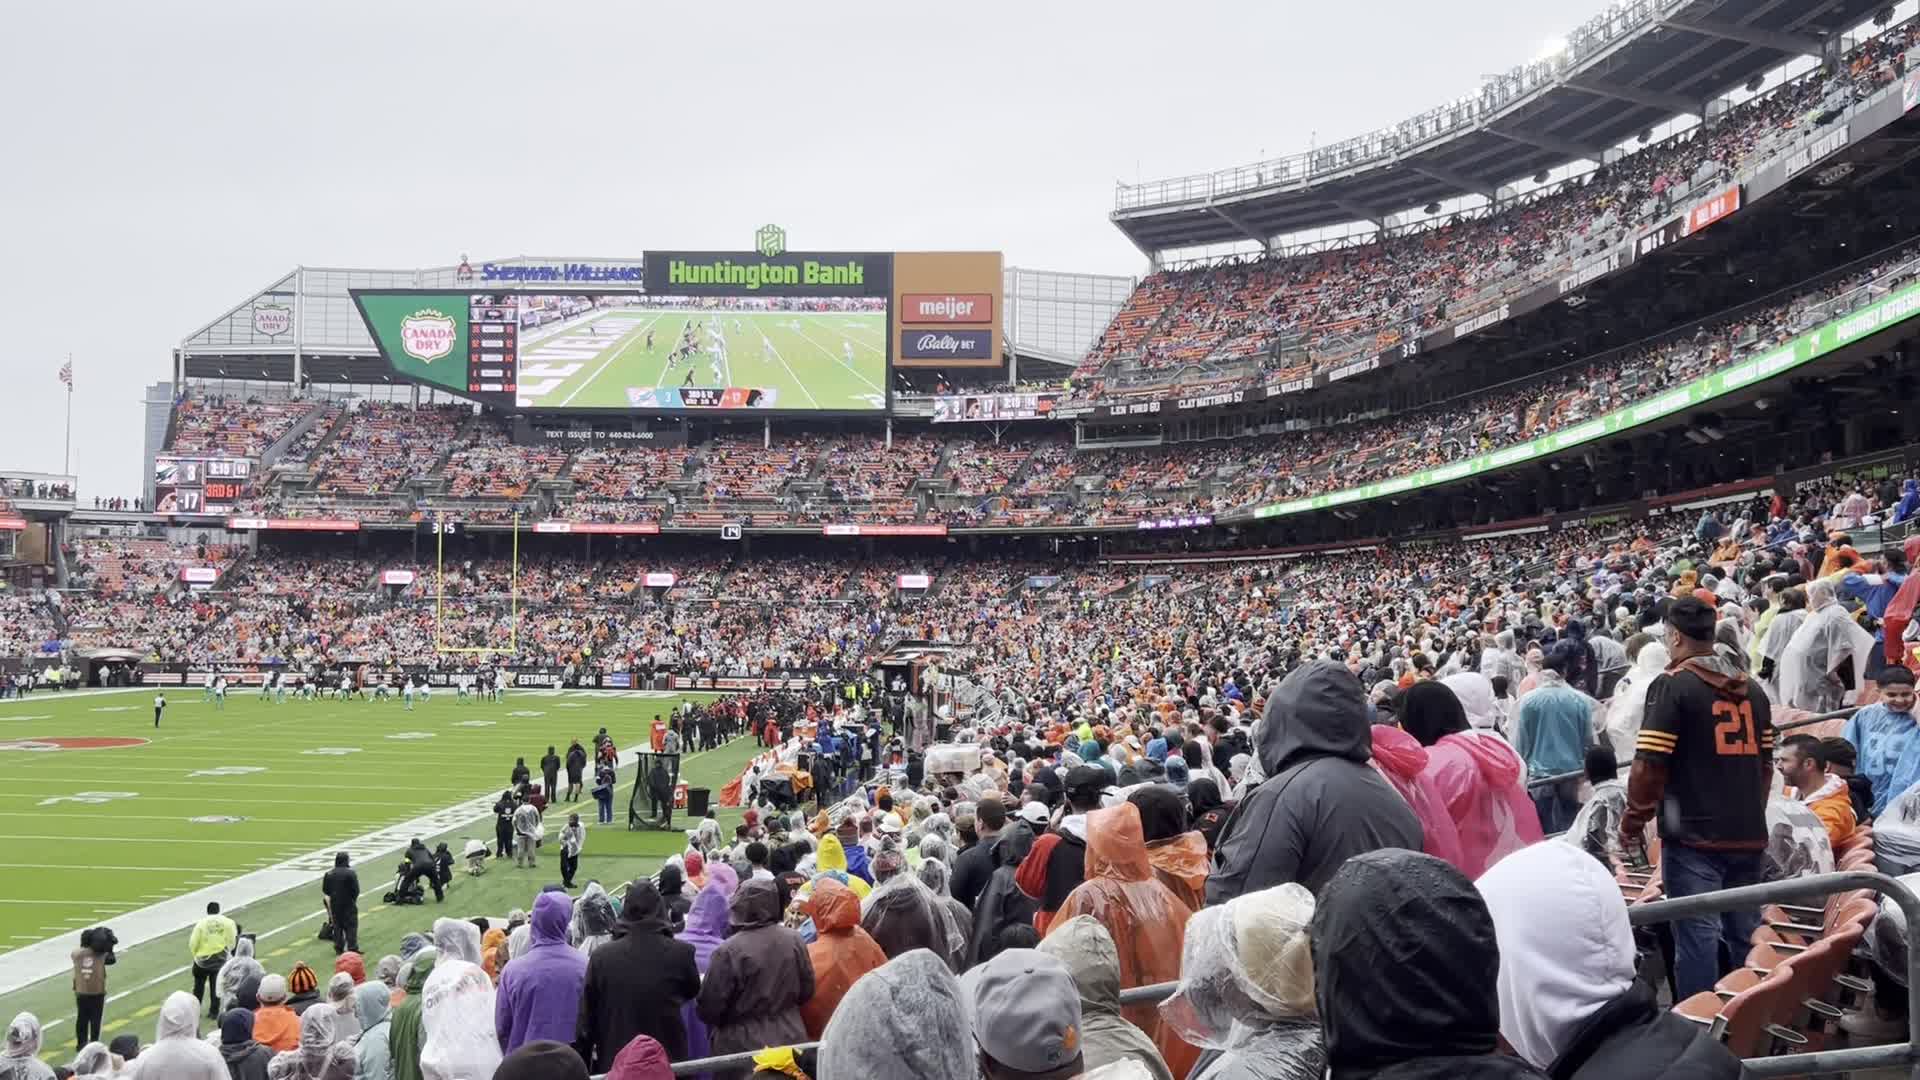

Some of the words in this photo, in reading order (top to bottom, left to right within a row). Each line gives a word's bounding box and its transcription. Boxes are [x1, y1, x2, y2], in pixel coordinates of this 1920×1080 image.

[482, 263, 642, 281] SHERWIN-WILLIAMS
[669, 260, 798, 289] Huntington
[803, 260, 864, 284] Bank
[919, 296, 974, 319] meijer
[255, 314, 291, 322] CANADA
[402, 327, 455, 339] CANADA
[415, 340, 441, 350] DRY
[917, 334, 959, 353] Bally
[961, 340, 976, 350] BET
[545, 431, 563, 439] TEXT
[567, 431, 592, 439] ISSUES
[595, 431, 606, 439] TO
[187, 464, 196, 481] 3
[207, 484, 225, 498] 3RD
[226, 484, 234, 498] &
[184, 492, 199, 510] 17
[727, 527, 739, 537] 14
[1712, 700, 1759, 755] 21
